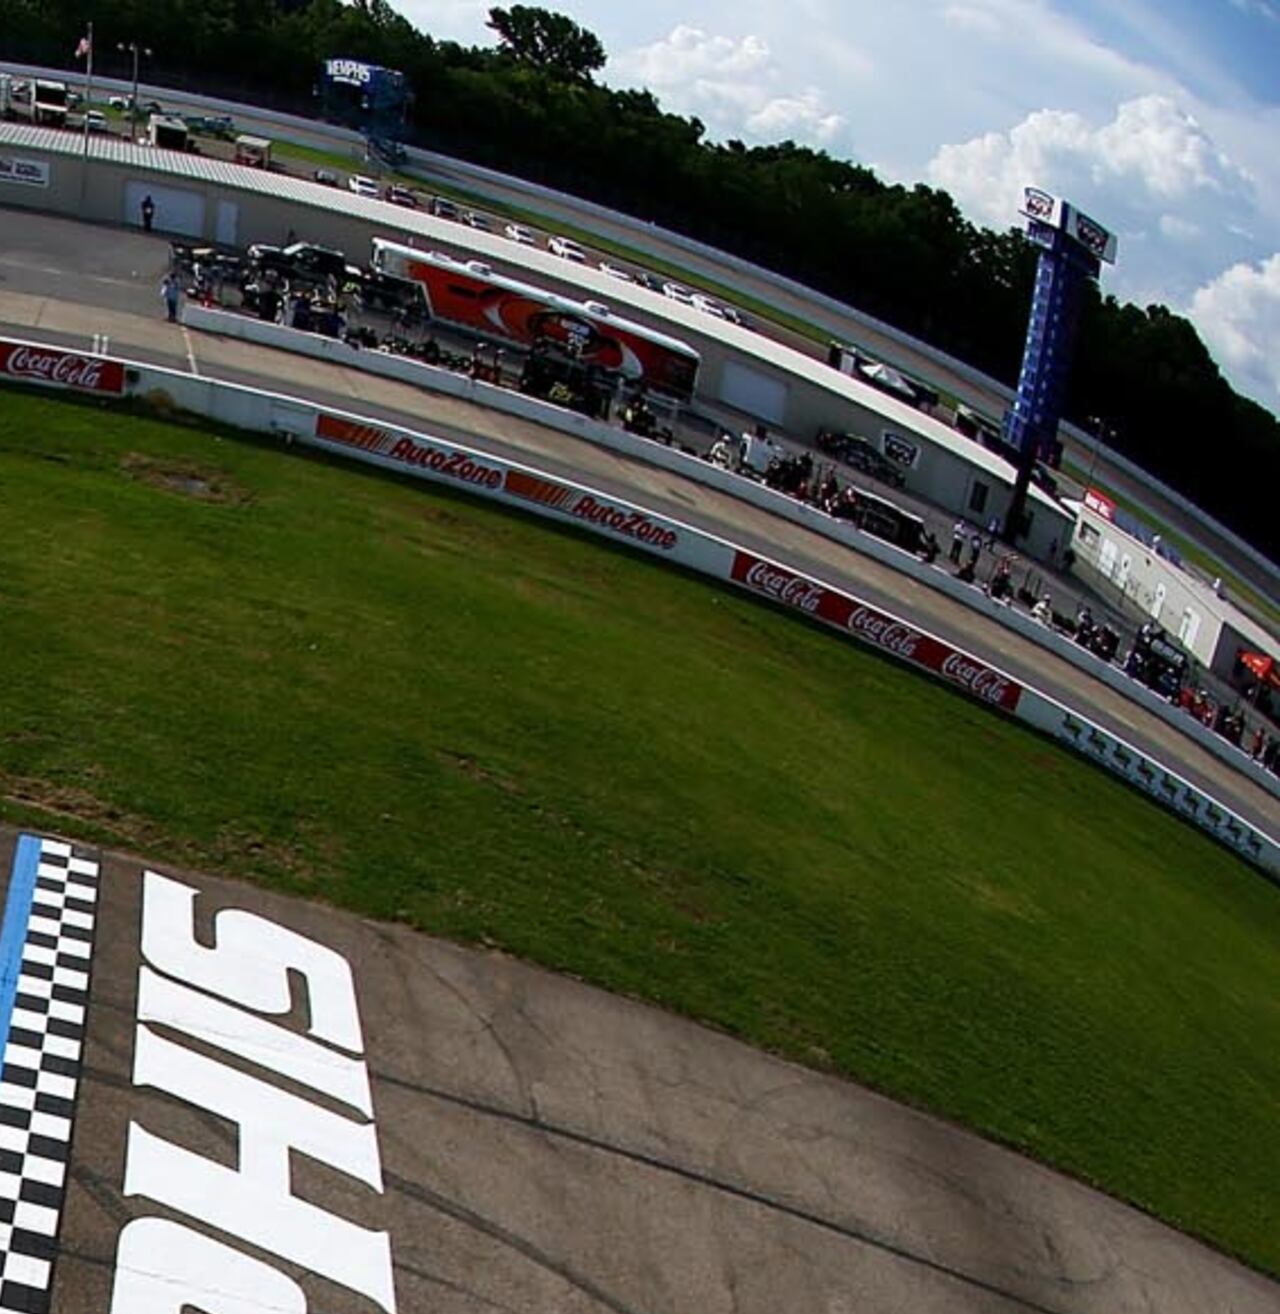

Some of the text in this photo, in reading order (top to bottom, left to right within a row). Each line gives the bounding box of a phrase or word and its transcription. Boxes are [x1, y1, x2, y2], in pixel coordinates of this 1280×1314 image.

[7, 347, 104, 389] Coca-Cola
[390, 438, 504, 489] AutoZone
[573, 497, 678, 550] AutoZone
[745, 561, 821, 612] Coca-Cola
[847, 607, 918, 657] Coca-Cola
[942, 652, 1006, 703] Coca-Cola
